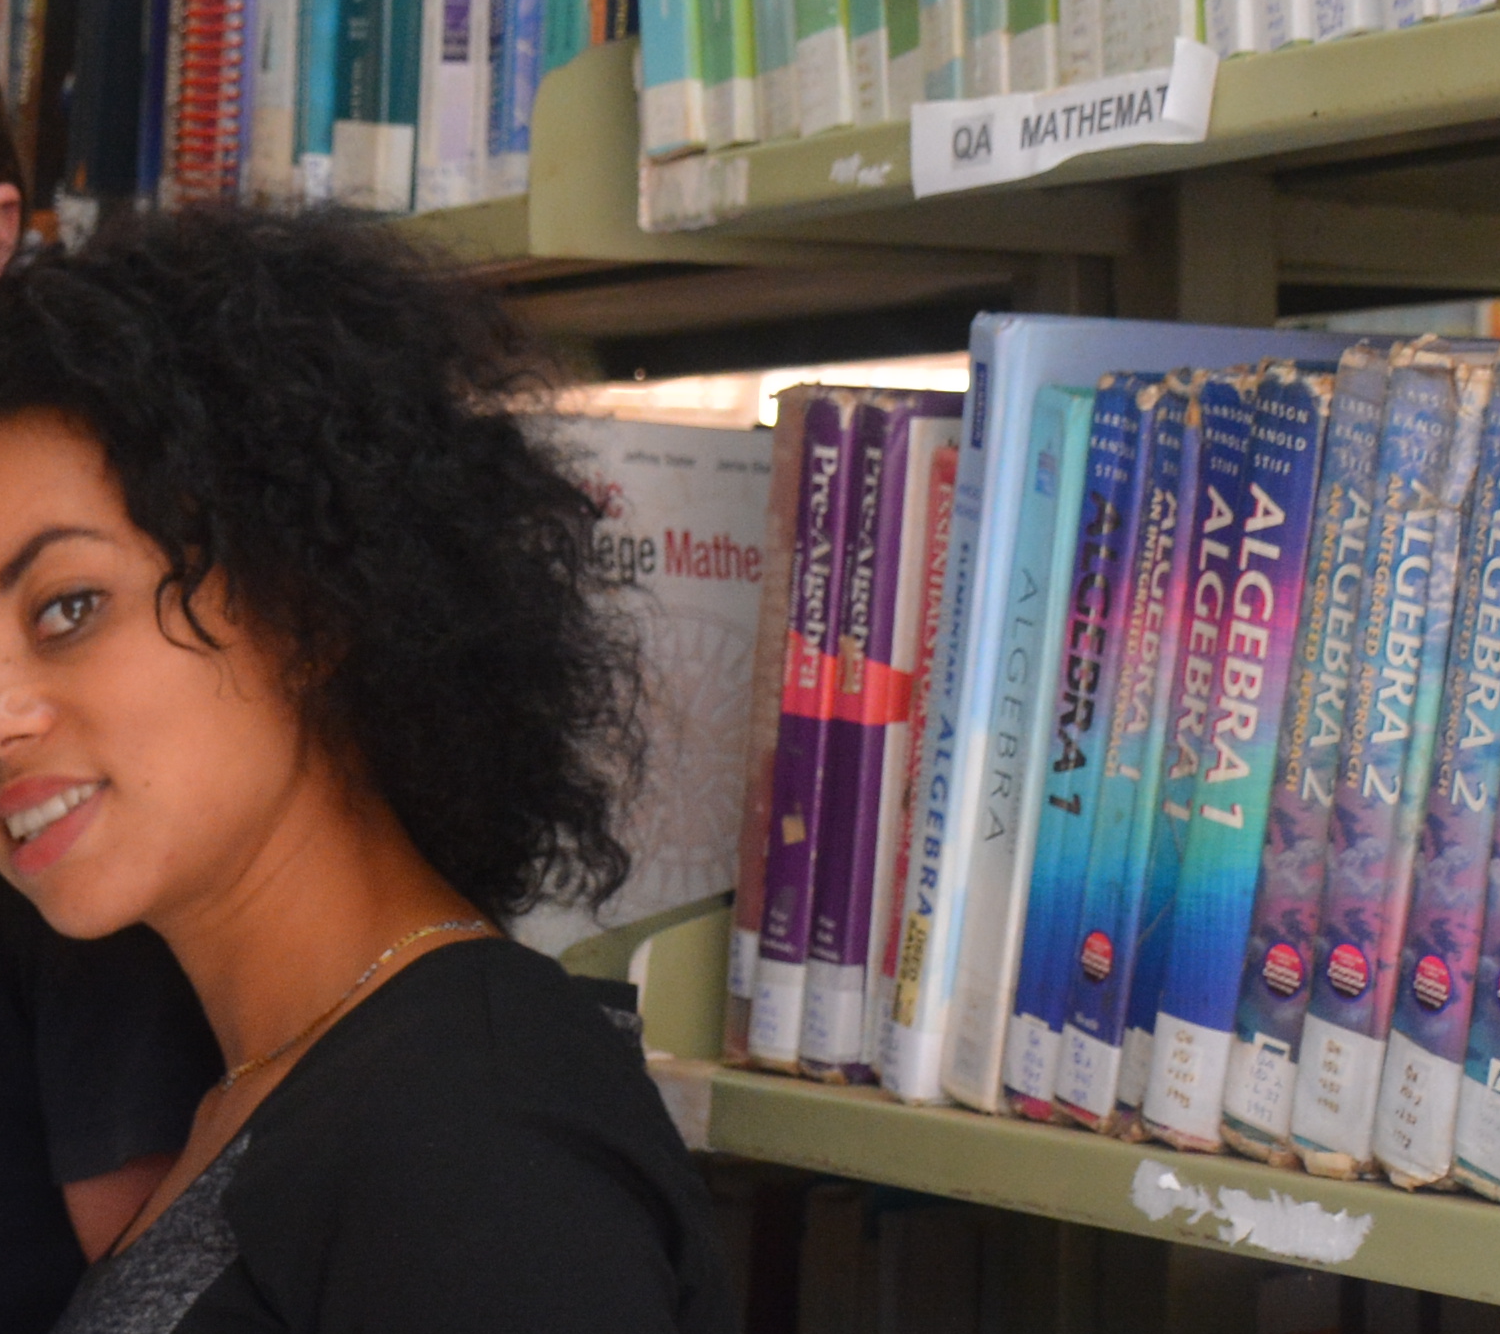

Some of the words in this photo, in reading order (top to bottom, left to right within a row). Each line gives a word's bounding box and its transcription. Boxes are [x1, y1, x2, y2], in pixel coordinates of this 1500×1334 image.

[952, 115, 993, 160] QA
[662, 529, 761, 584] Mathe
[1205, 481, 1286, 784] ALGEBRA
[983, 569, 1039, 845] ALGEBRA
[1199, 803, 1244, 831] 1
